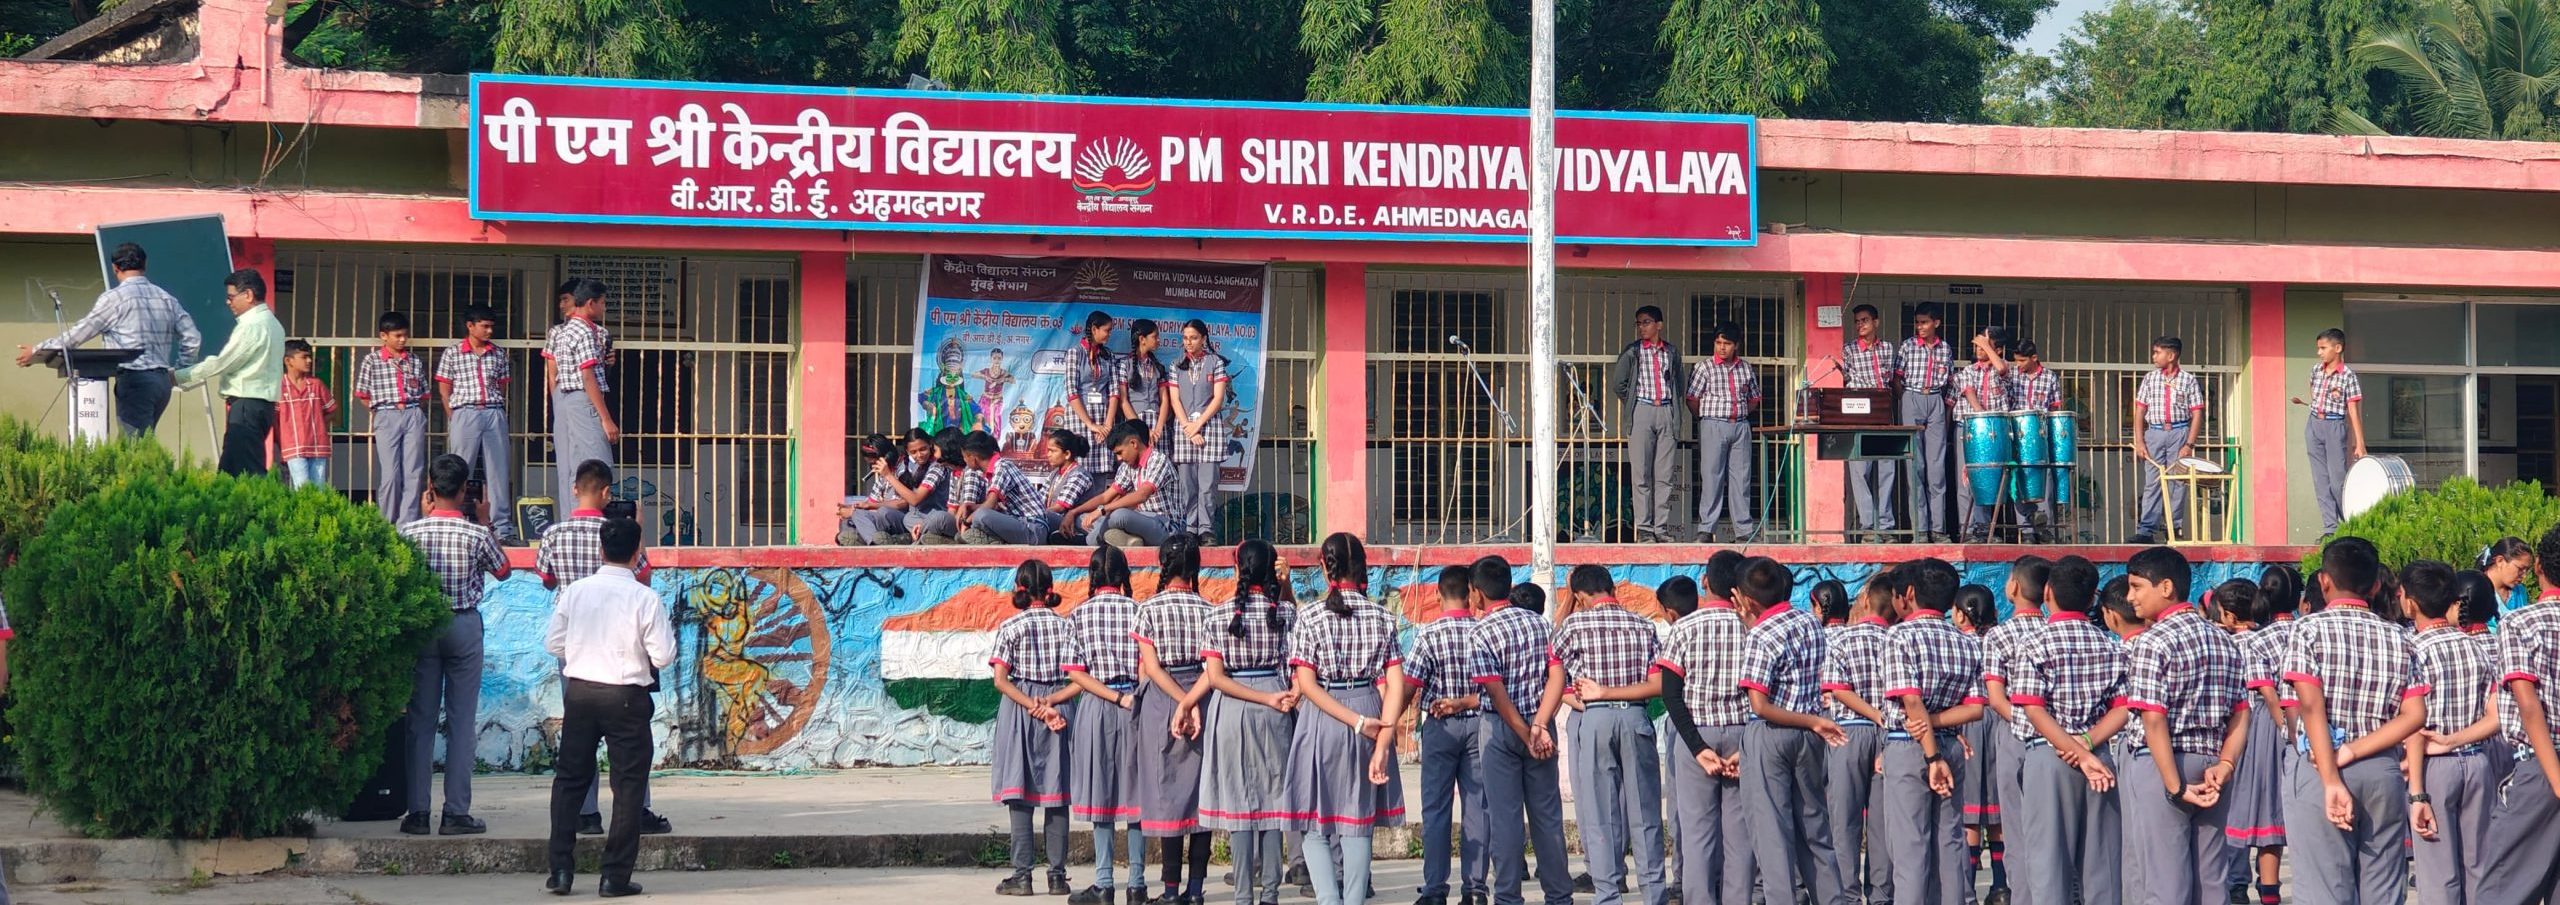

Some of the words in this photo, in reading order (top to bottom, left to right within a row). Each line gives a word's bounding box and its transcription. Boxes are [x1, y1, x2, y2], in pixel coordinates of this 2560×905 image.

[484, 98, 541, 164] पी
[547, 117, 632, 166] एम
[646, 104, 716, 169] श्री
[722, 103, 875, 180] केन्द्रीय
[881, 112, 1077, 180] विद्यालय
[1161, 136, 1223, 183] PM
[1240, 138, 1329, 186] SHRI
[1343, 142, 1528, 191] KENDRIYA
[848, 188, 985, 222] अहमदनगर
[1373, 206, 1533, 229] AHMEDNAGA
[1133, 270, 1170, 282] KENDRIYA
[1172, 272, 1213, 285] VIDYALAYA
[1214, 275, 1259, 288] SANGHATAN
[1165, 287, 1197, 298] MUMBAI
[1198, 288, 1227, 300] REGION
[931, 307, 940, 326] पी
[944, 311, 957, 326] एम
[83, 397, 96, 405] PM
[79, 410, 99, 418] SHRI
